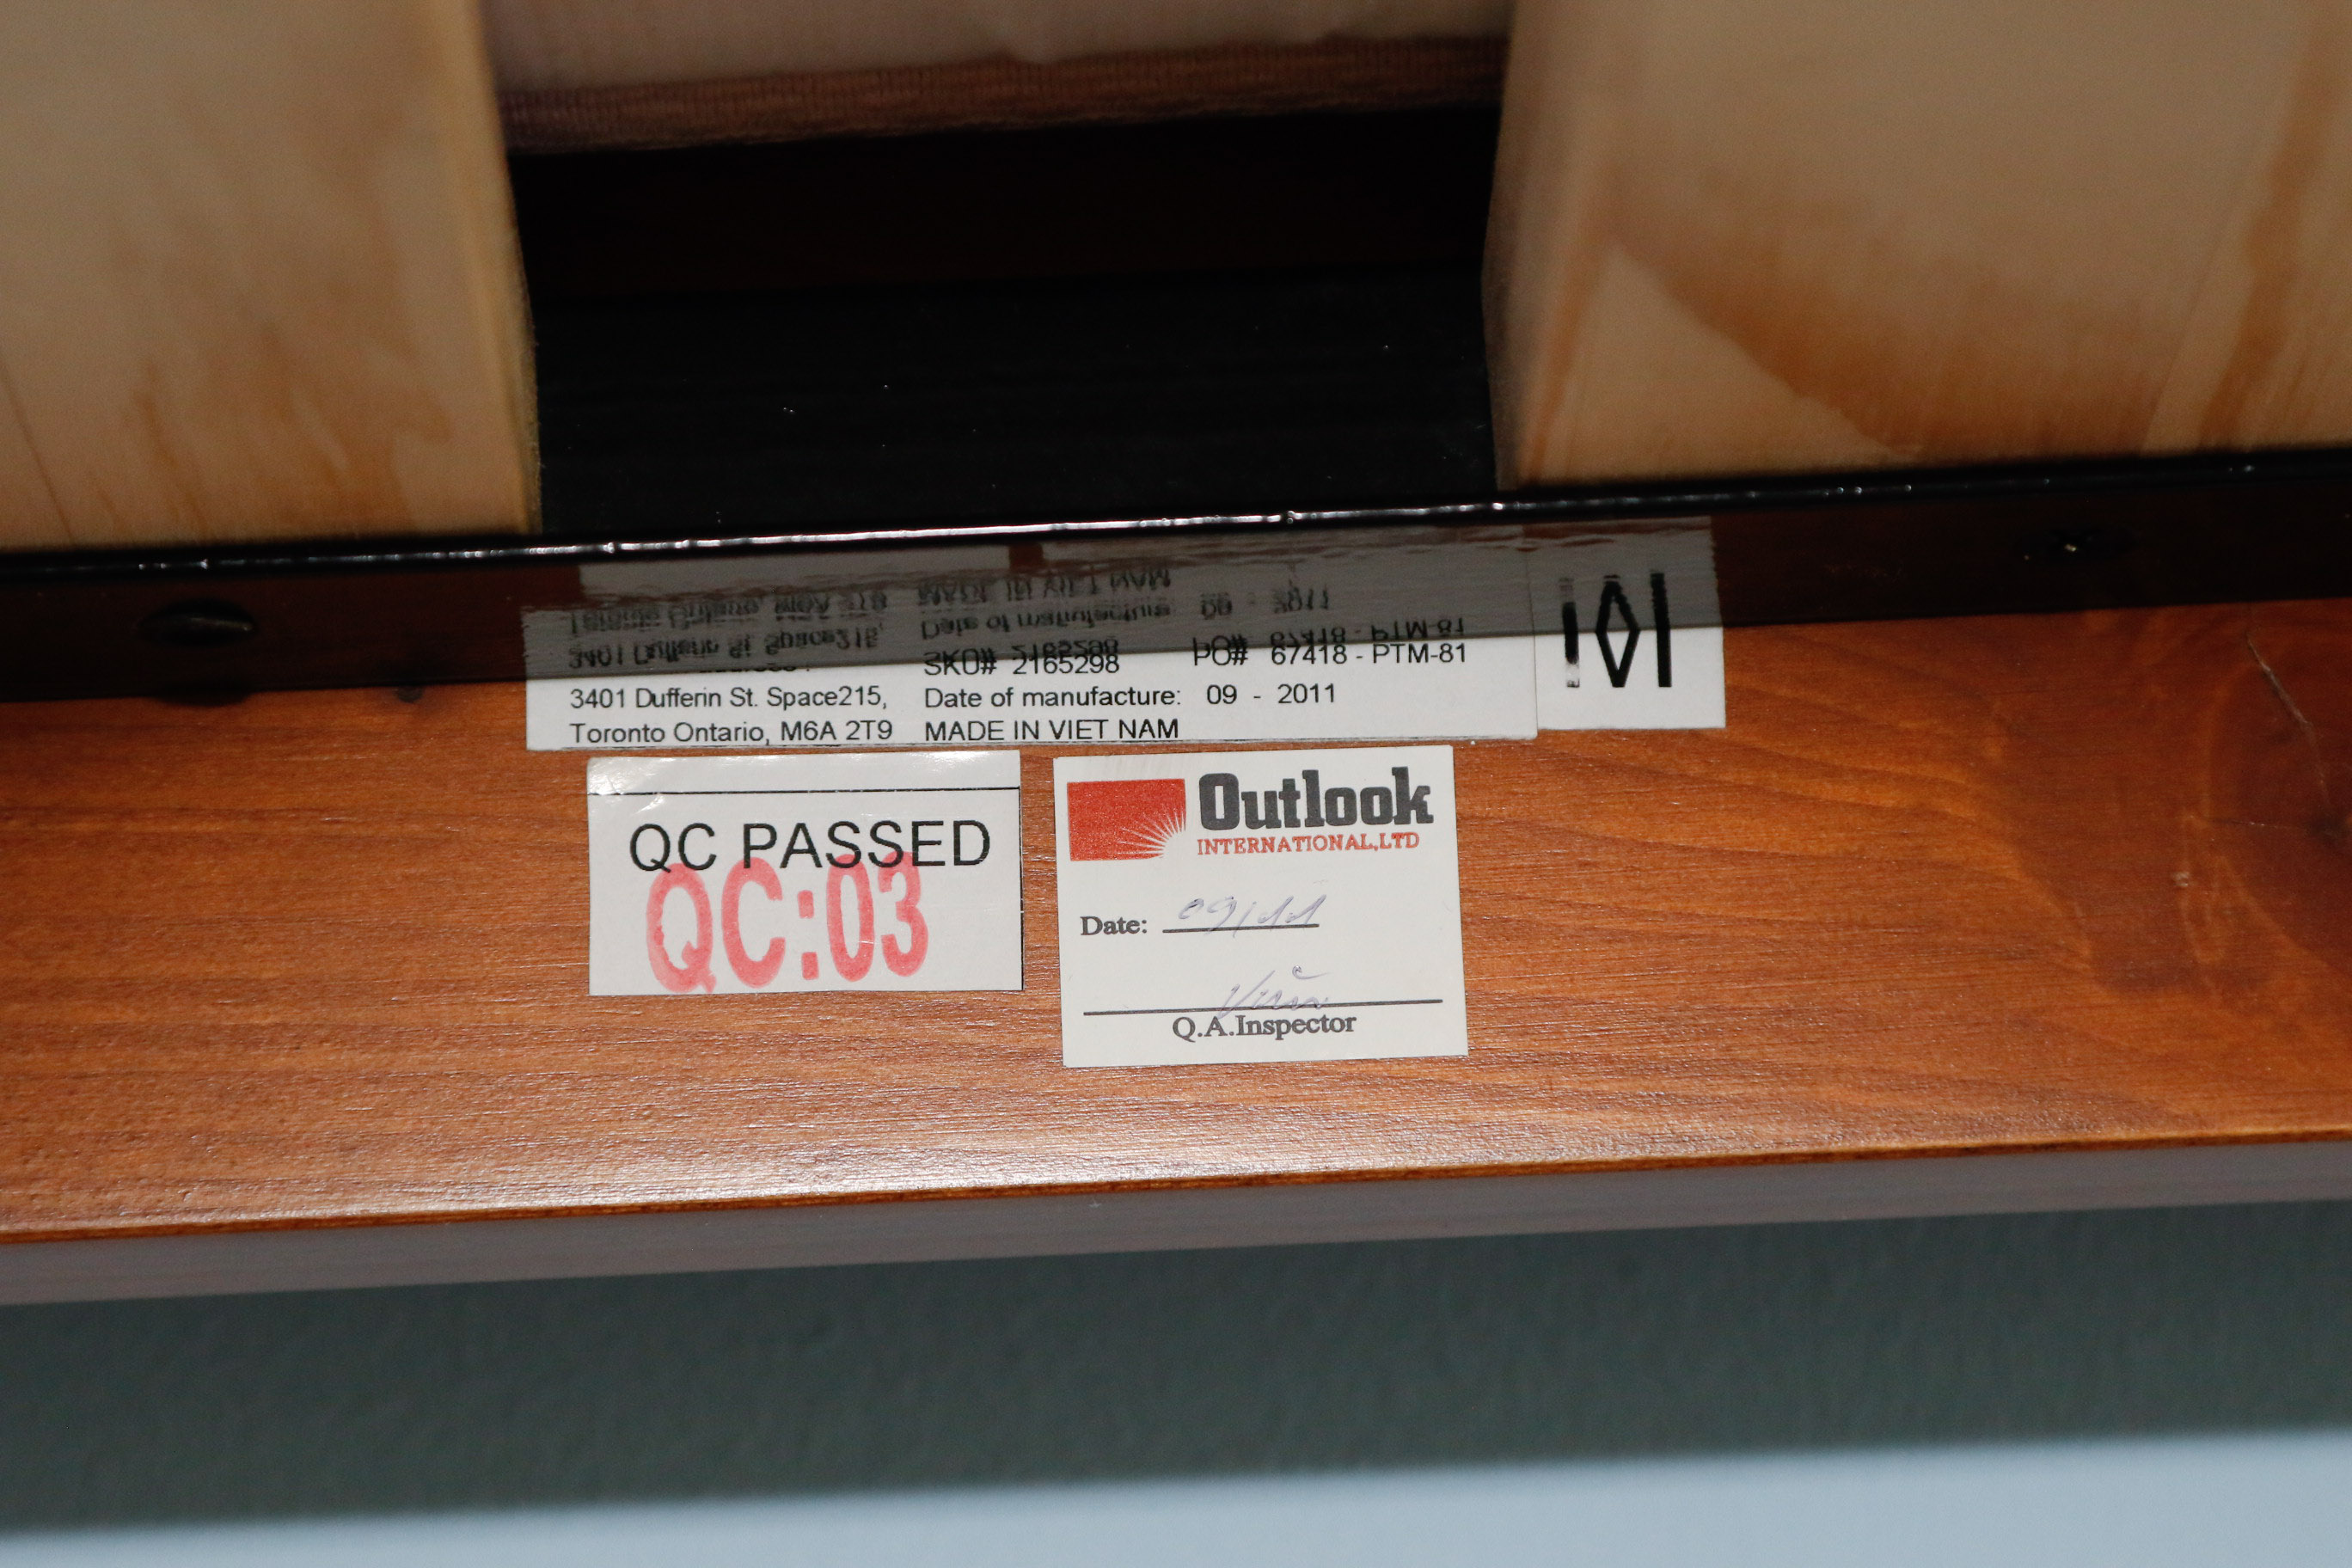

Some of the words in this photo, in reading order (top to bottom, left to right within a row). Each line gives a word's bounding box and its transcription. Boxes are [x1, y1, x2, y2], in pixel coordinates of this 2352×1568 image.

[1013, 653, 1120, 675] 2165298
[1193, 644, 1249, 666] PO#
[1271, 645, 1348, 665] 67418
[1372, 643, 1467, 664] PTM-81
[570, 688, 626, 709] 3401
[635, 687, 722, 708] Dufferin
[729, 686, 758, 707] St.
[925, 687, 983, 708] Date
[990, 686, 1014, 707] of
[1022, 685, 1182, 707] manufacture:
[1206, 683, 1238, 705] 09
[1277, 683, 1336, 704] 2011
[569, 722, 666, 744] Toronto
[673, 721, 770, 746] Ontario,
[781, 720, 837, 741] M6A
[845, 720, 893, 741] 2T9
[925, 720, 1005, 741] MADE
[1014, 720, 1039, 740] IN
[1048, 719, 1110, 740] VIET
[1118, 718, 1179, 739] NAM
[1198, 766, 1435, 831] Outlook
[629, 823, 717, 873] QC
[742, 819, 990, 870] PASSED
[646, 851, 929, 994] QC:03
[1080, 916, 1148, 936] Date:
